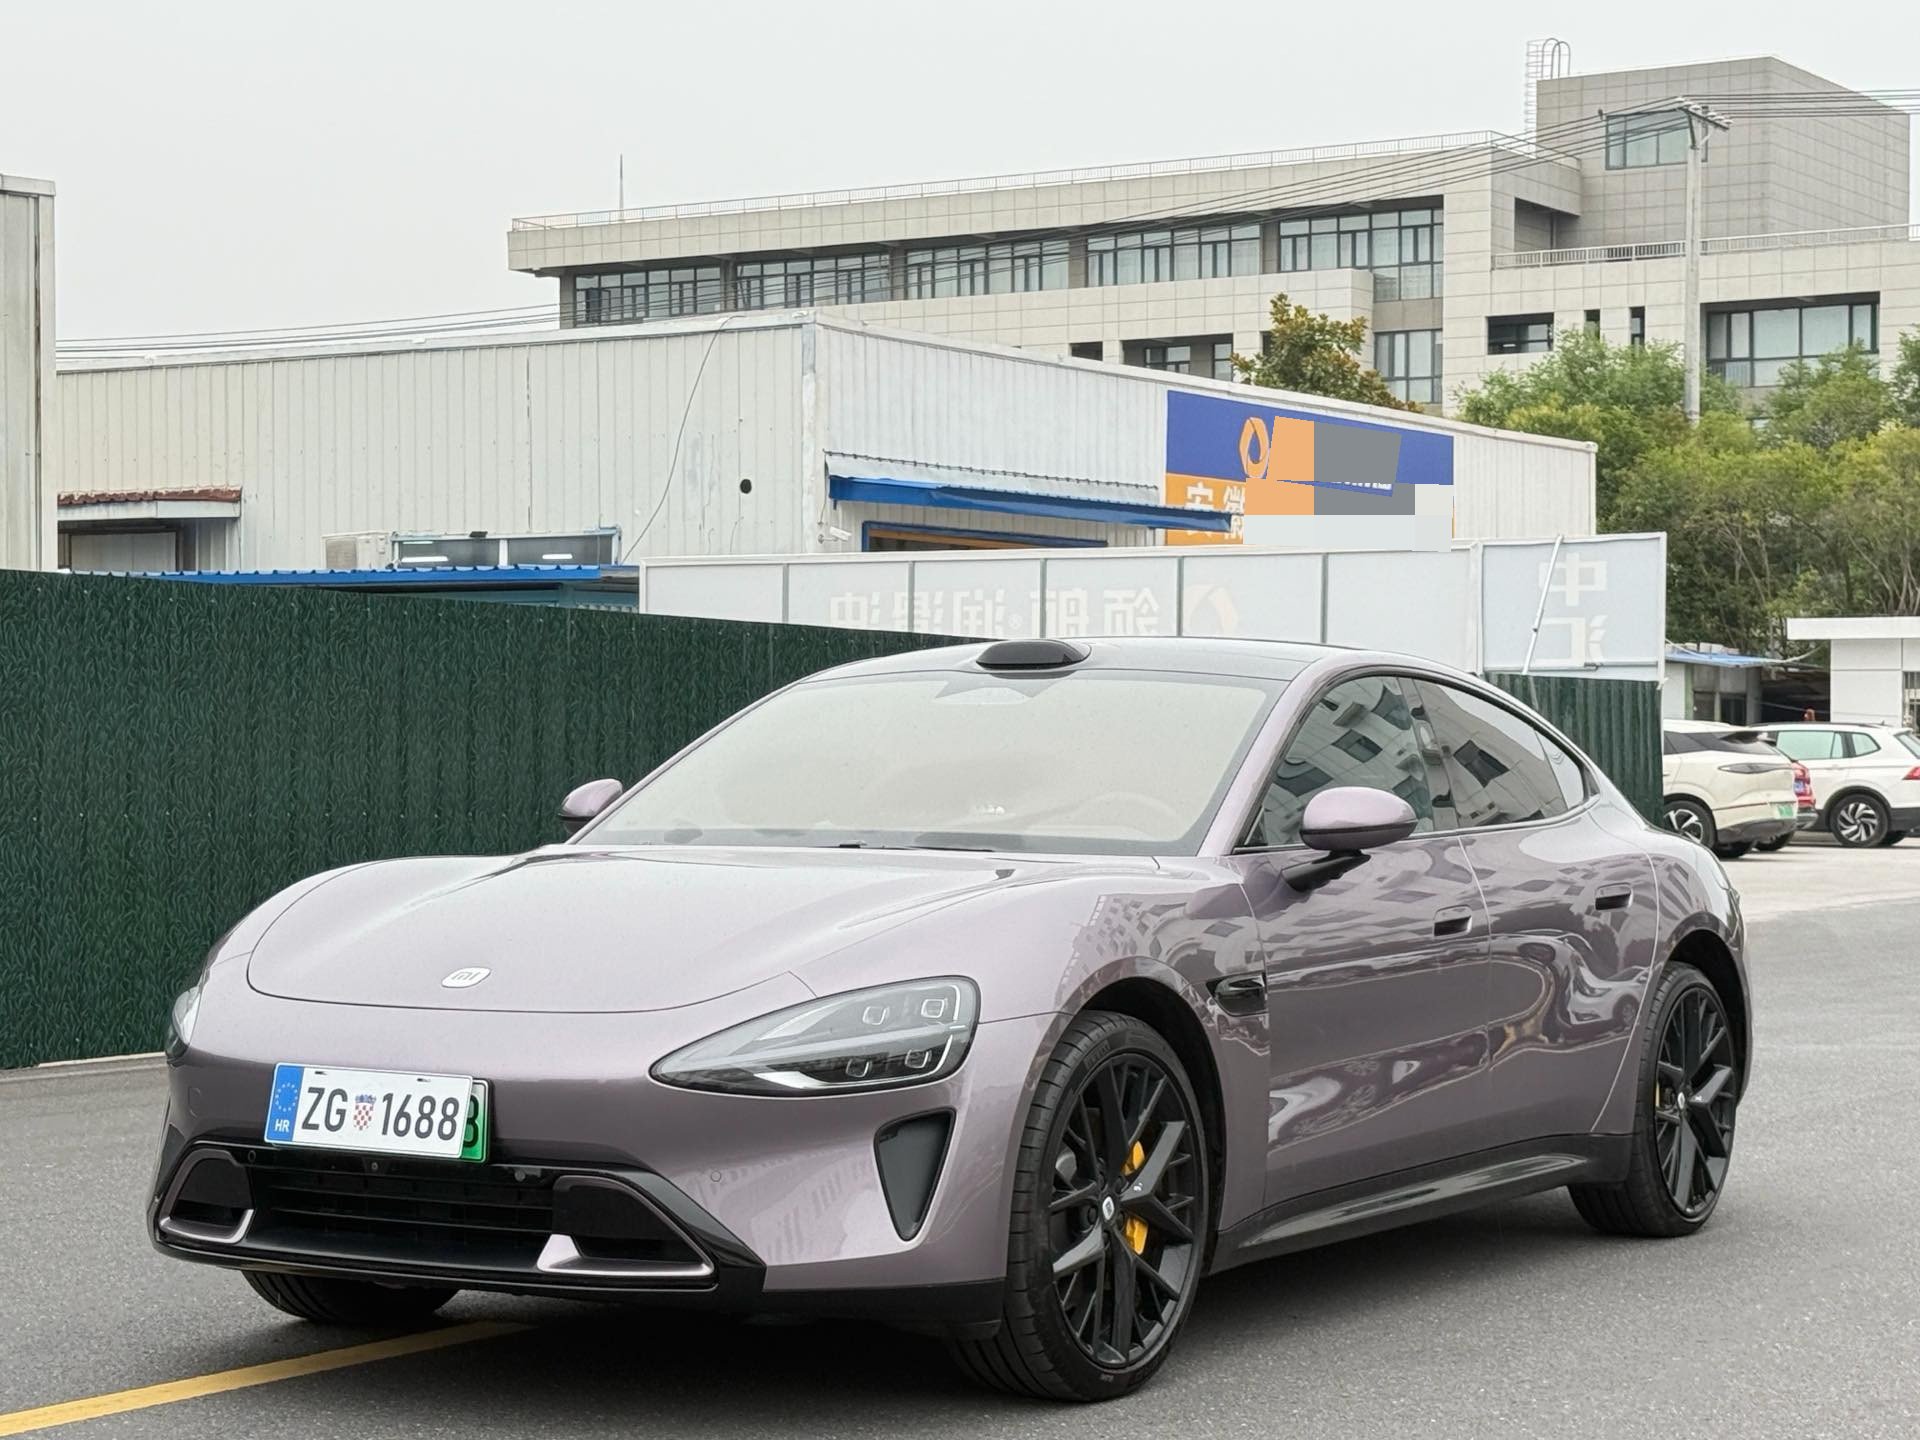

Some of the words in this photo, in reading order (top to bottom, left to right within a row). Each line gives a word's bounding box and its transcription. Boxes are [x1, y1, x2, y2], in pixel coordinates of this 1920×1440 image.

[274, 1118, 290, 1133] HR
[301, 1086, 349, 1132] ZG
[381, 1092, 460, 1141] 1688
